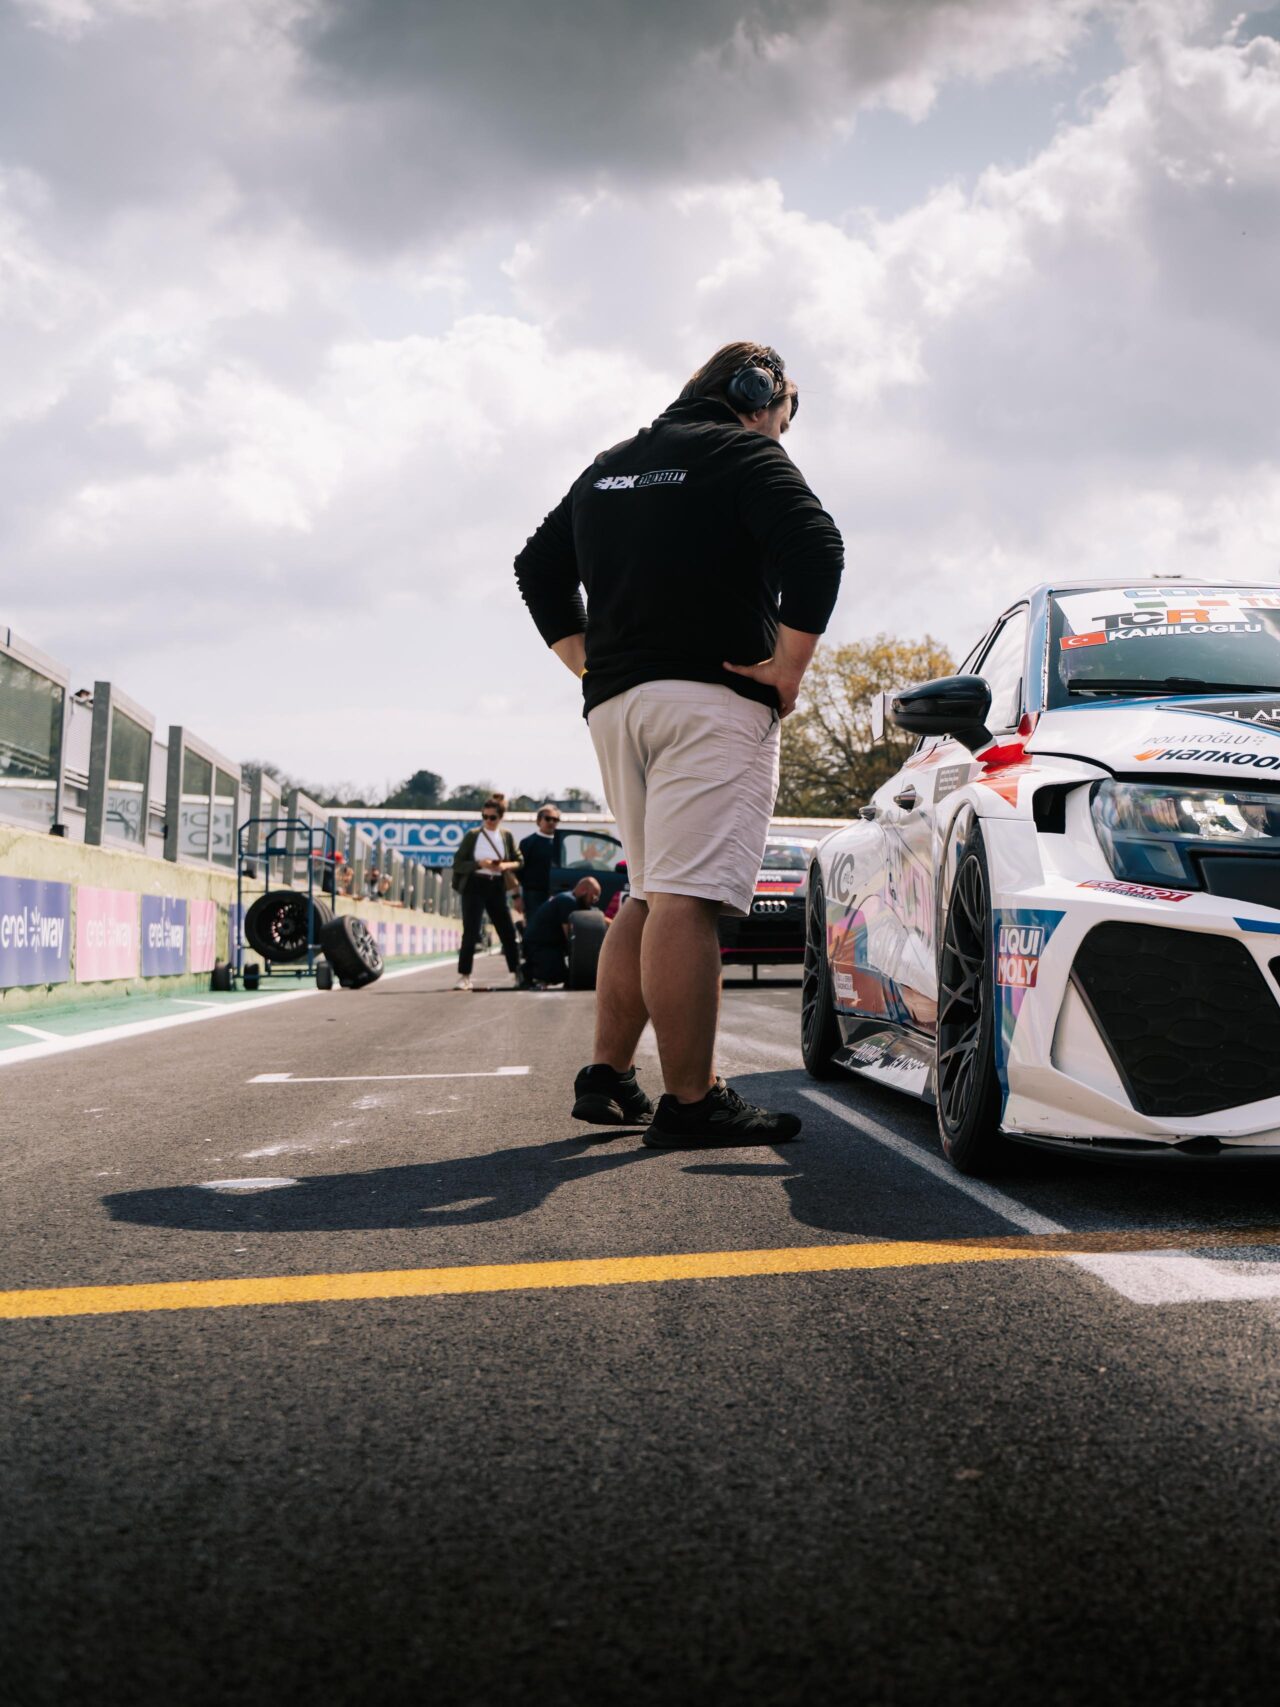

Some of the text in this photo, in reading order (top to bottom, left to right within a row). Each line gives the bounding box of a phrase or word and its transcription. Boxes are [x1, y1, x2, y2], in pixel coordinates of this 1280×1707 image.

[599, 475, 640, 490] H2K
[1092, 609, 1210, 630] TCR
[1109, 623, 1262, 641] KAMILOGLU
[826, 851, 855, 903] KC
[1, 906, 64, 959] enel way
[149, 915, 164, 948] enel
[170, 924, 184, 956] way
[1000, 928, 1041, 955] LIQUI
[998, 957, 1038, 985] MOLY
